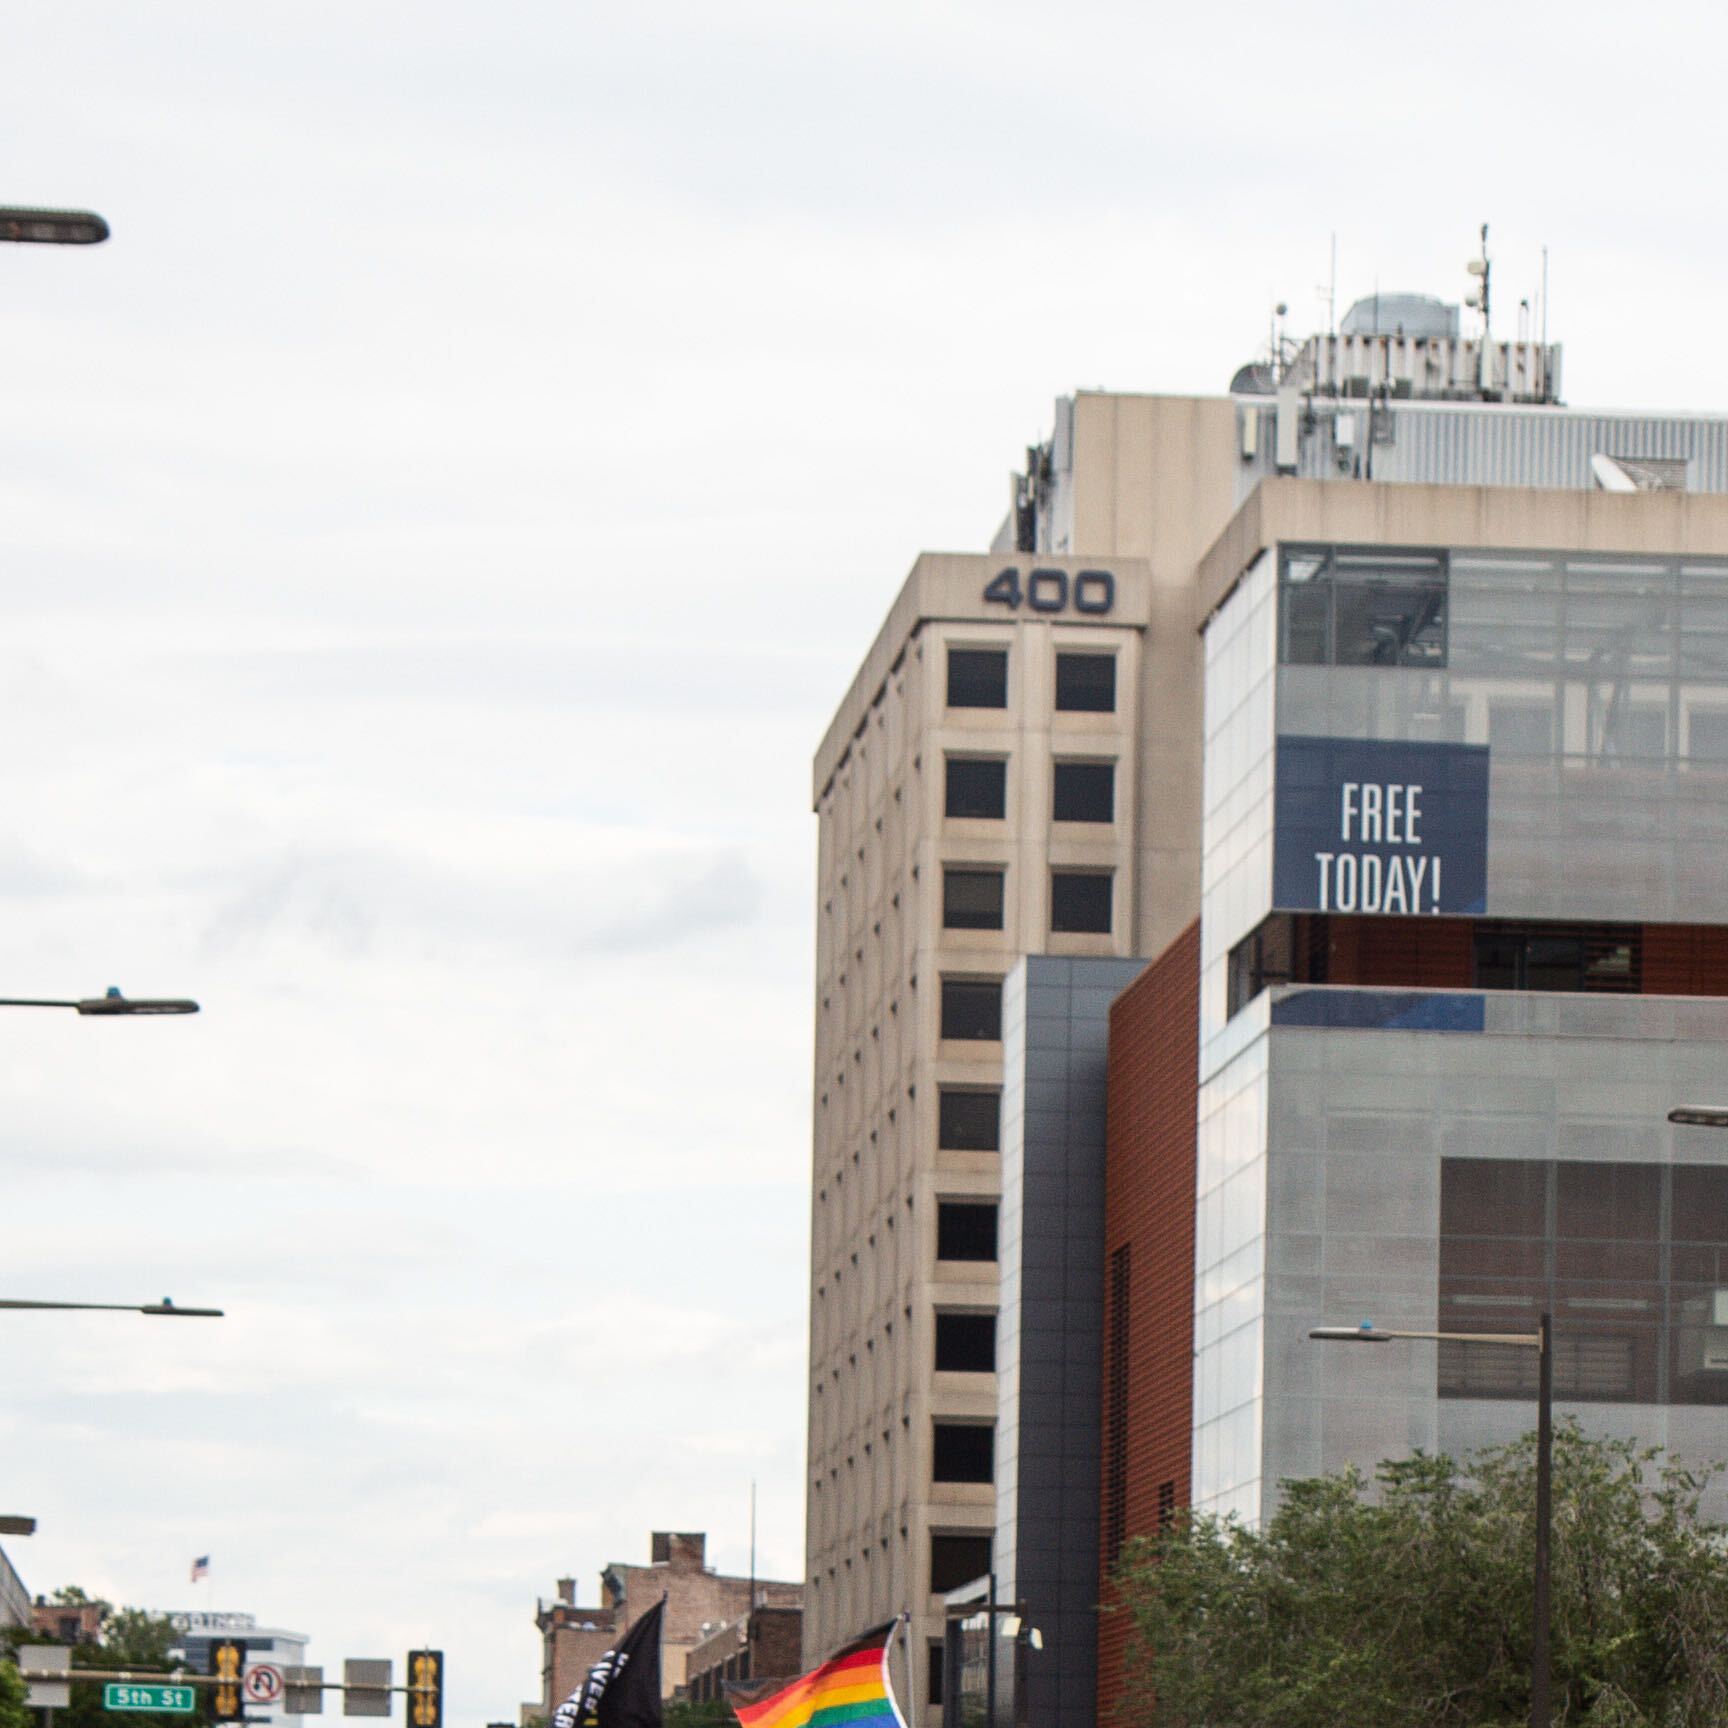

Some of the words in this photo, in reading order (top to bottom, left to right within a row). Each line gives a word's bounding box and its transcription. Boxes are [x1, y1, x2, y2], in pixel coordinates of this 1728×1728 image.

[982, 566, 1115, 615] 400
[1341, 783, 1423, 844] FREE
[1315, 852, 1441, 915] TODAY!
[117, 1688, 152, 1705] 5th
[162, 1689, 183, 1706] St
